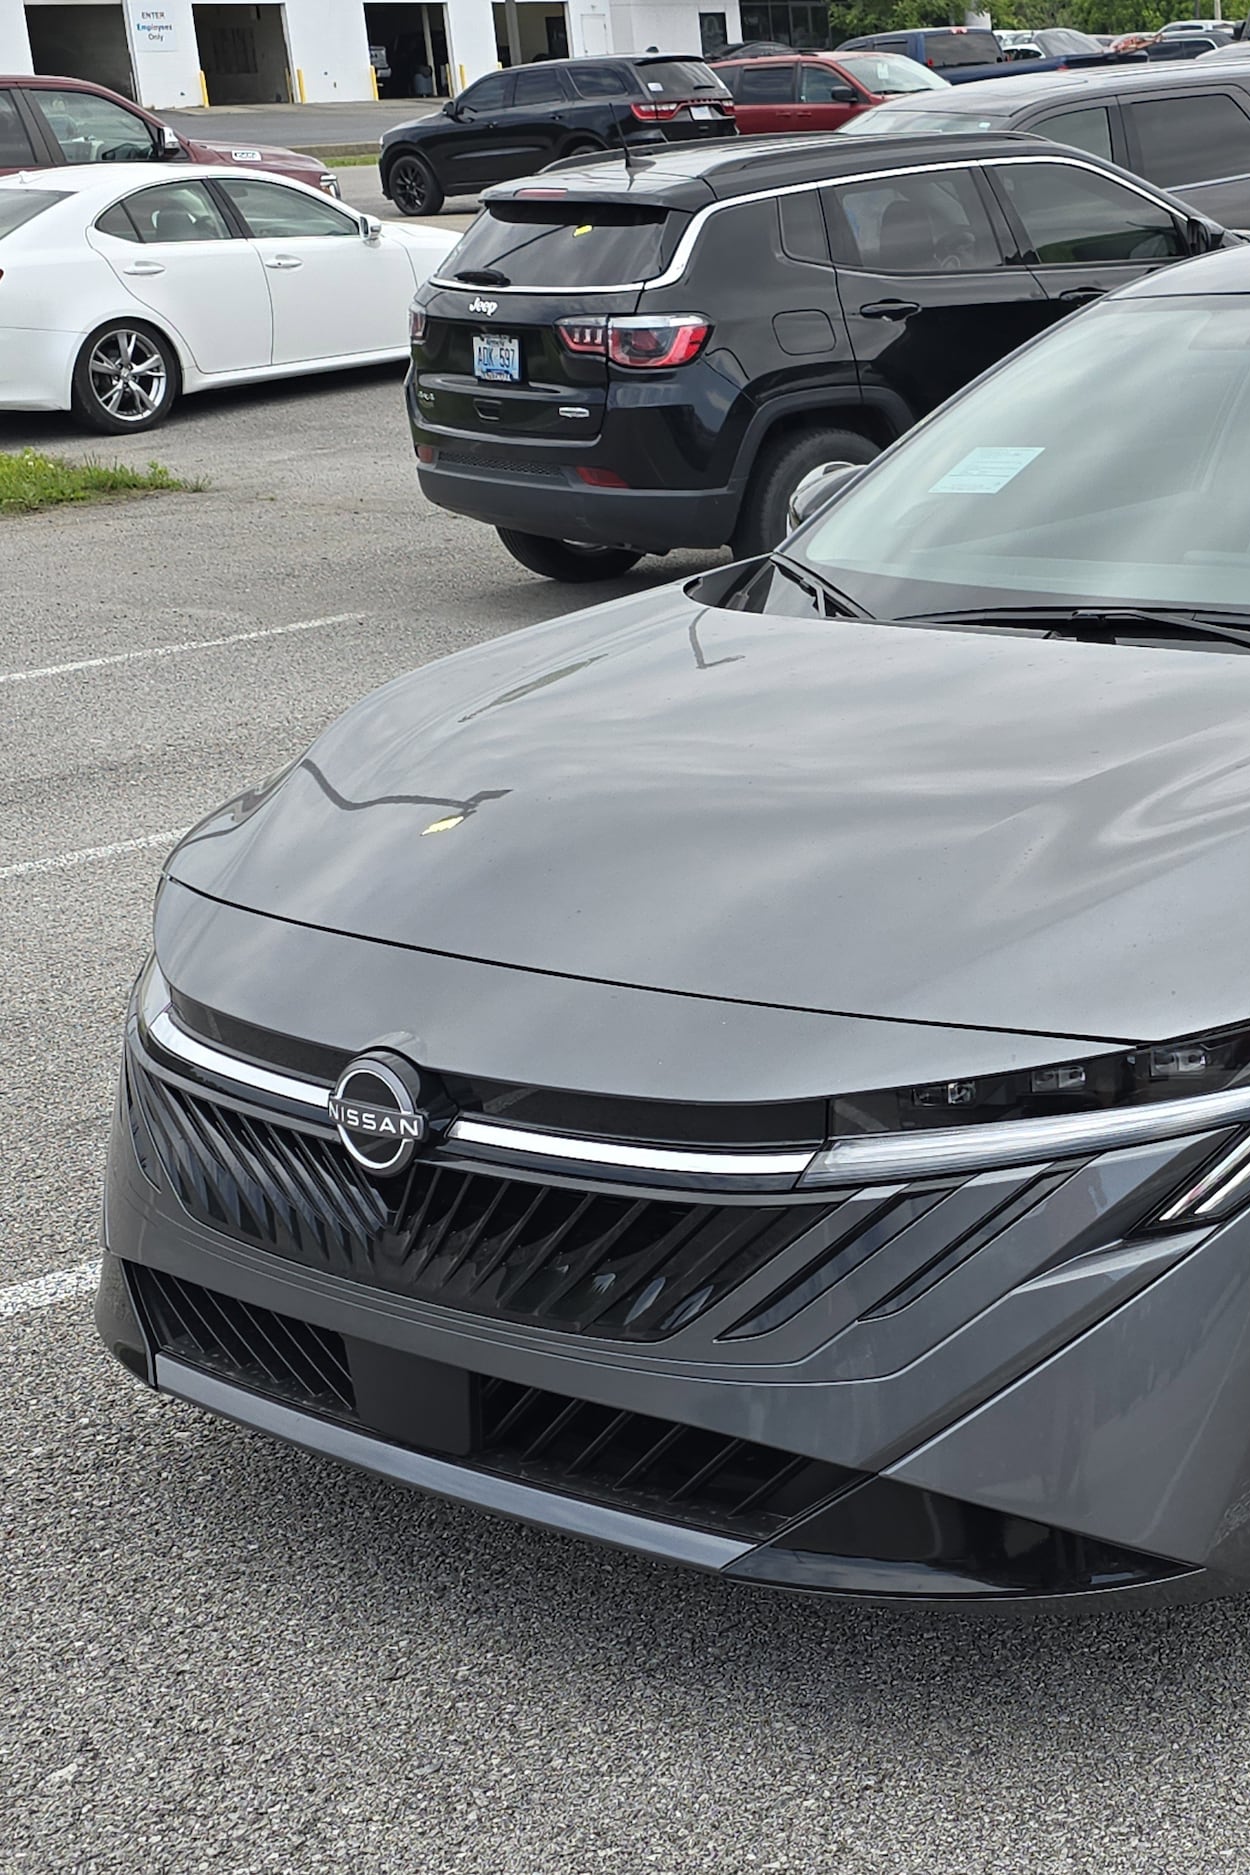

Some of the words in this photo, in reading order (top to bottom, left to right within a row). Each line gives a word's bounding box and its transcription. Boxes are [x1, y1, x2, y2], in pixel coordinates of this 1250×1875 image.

[141, 11, 165, 20] ENTER
[147, 33, 164, 43] Only
[469, 296, 498, 316] Jeep
[499, 347, 516, 369] 597
[328, 1100, 419, 1137] NISSAN
